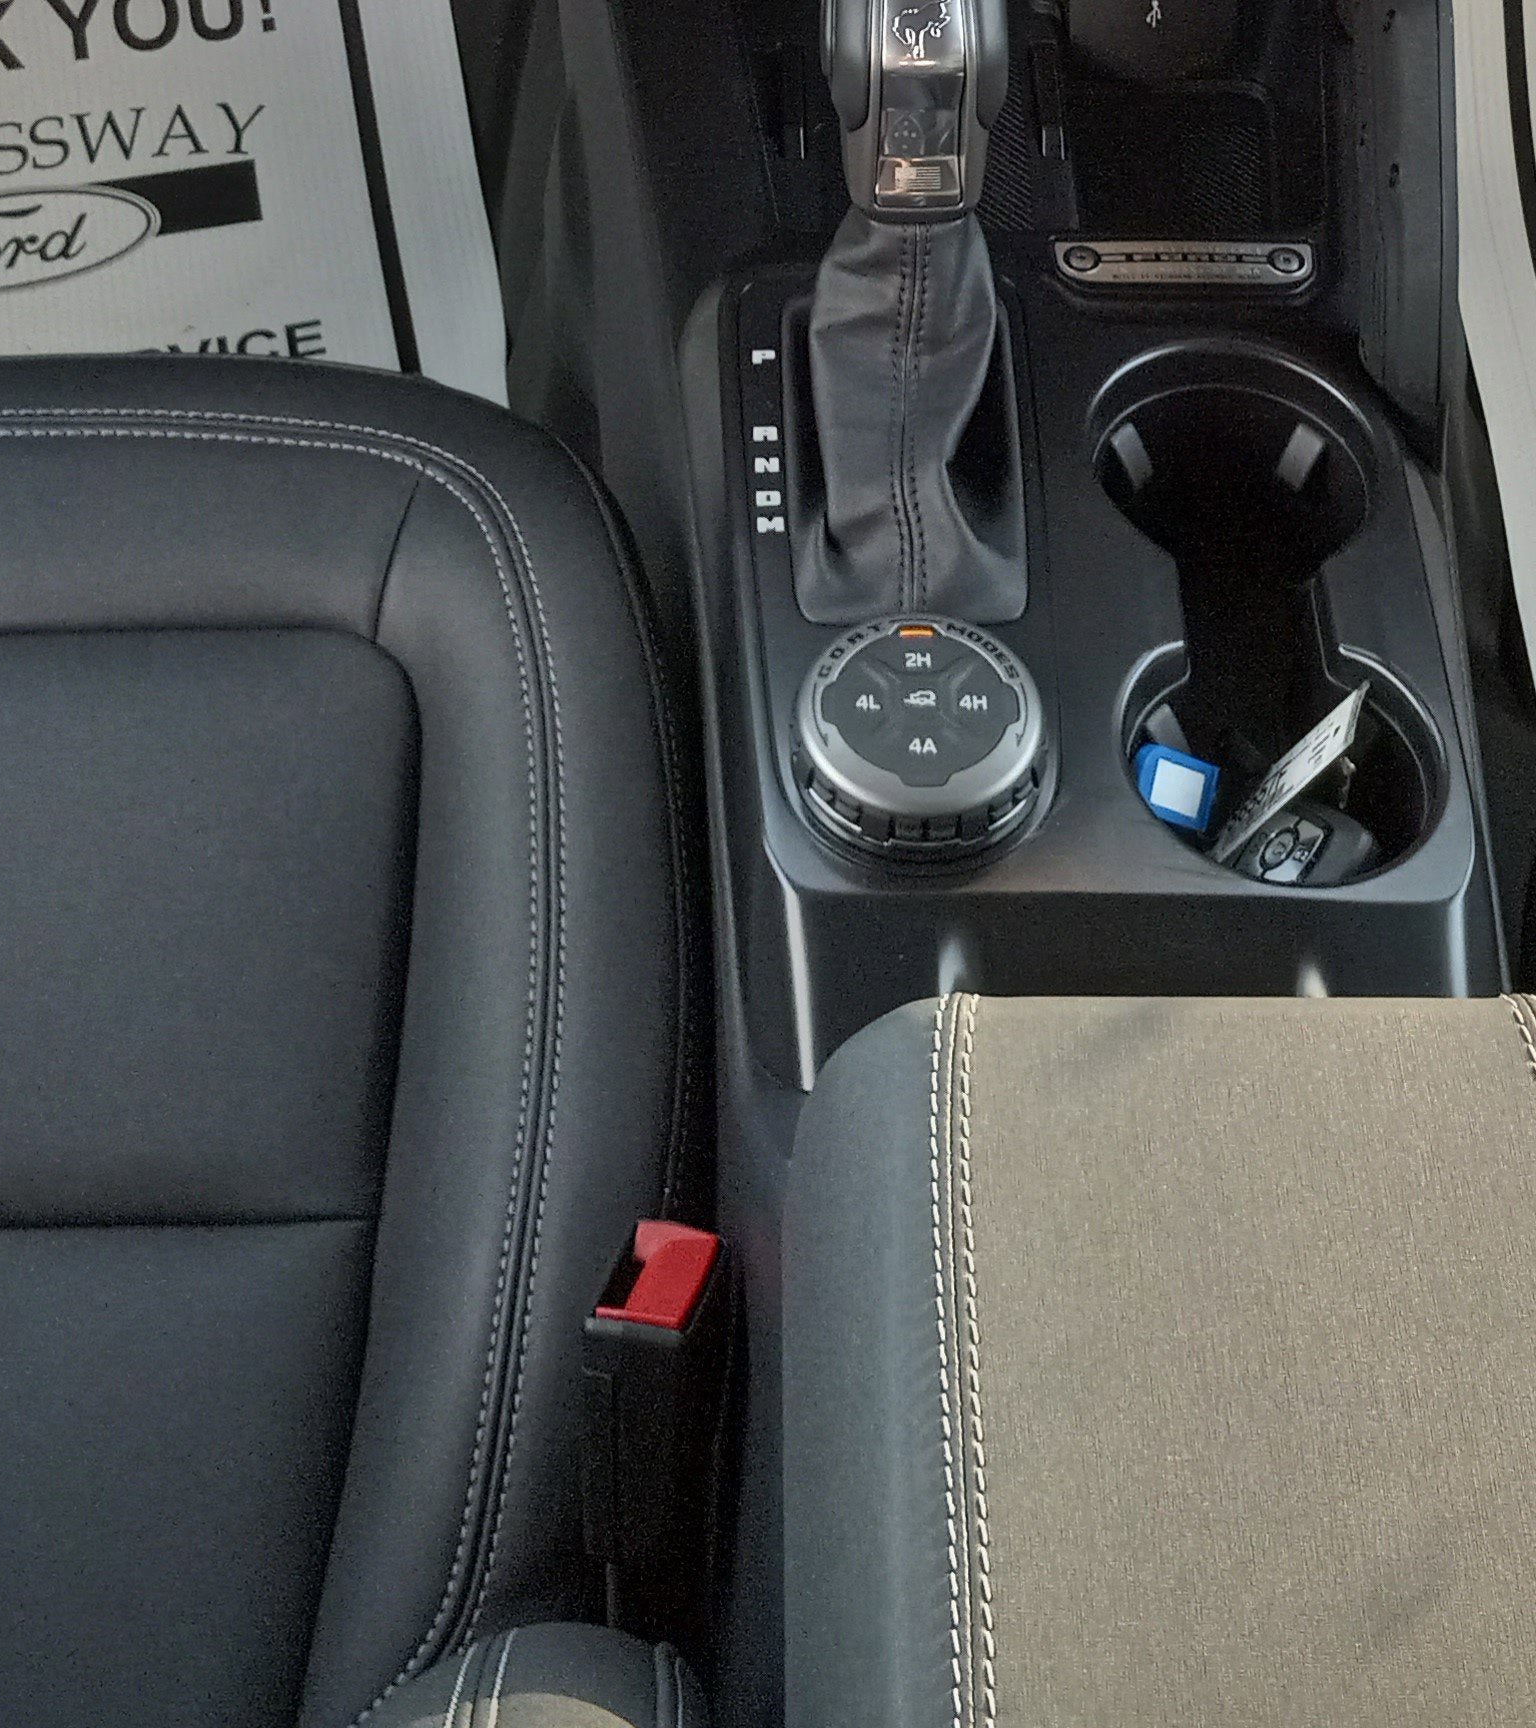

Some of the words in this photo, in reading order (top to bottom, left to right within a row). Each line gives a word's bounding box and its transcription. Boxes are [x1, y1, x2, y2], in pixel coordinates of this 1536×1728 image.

[752, 349, 776, 365] P
[754, 457, 780, 473] N
[756, 516, 785, 533] M
[904, 652, 932, 669] 2H
[855, 694, 881, 711] 4L
[959, 694, 988, 711] 4H
[908, 738, 937, 755] 4A
